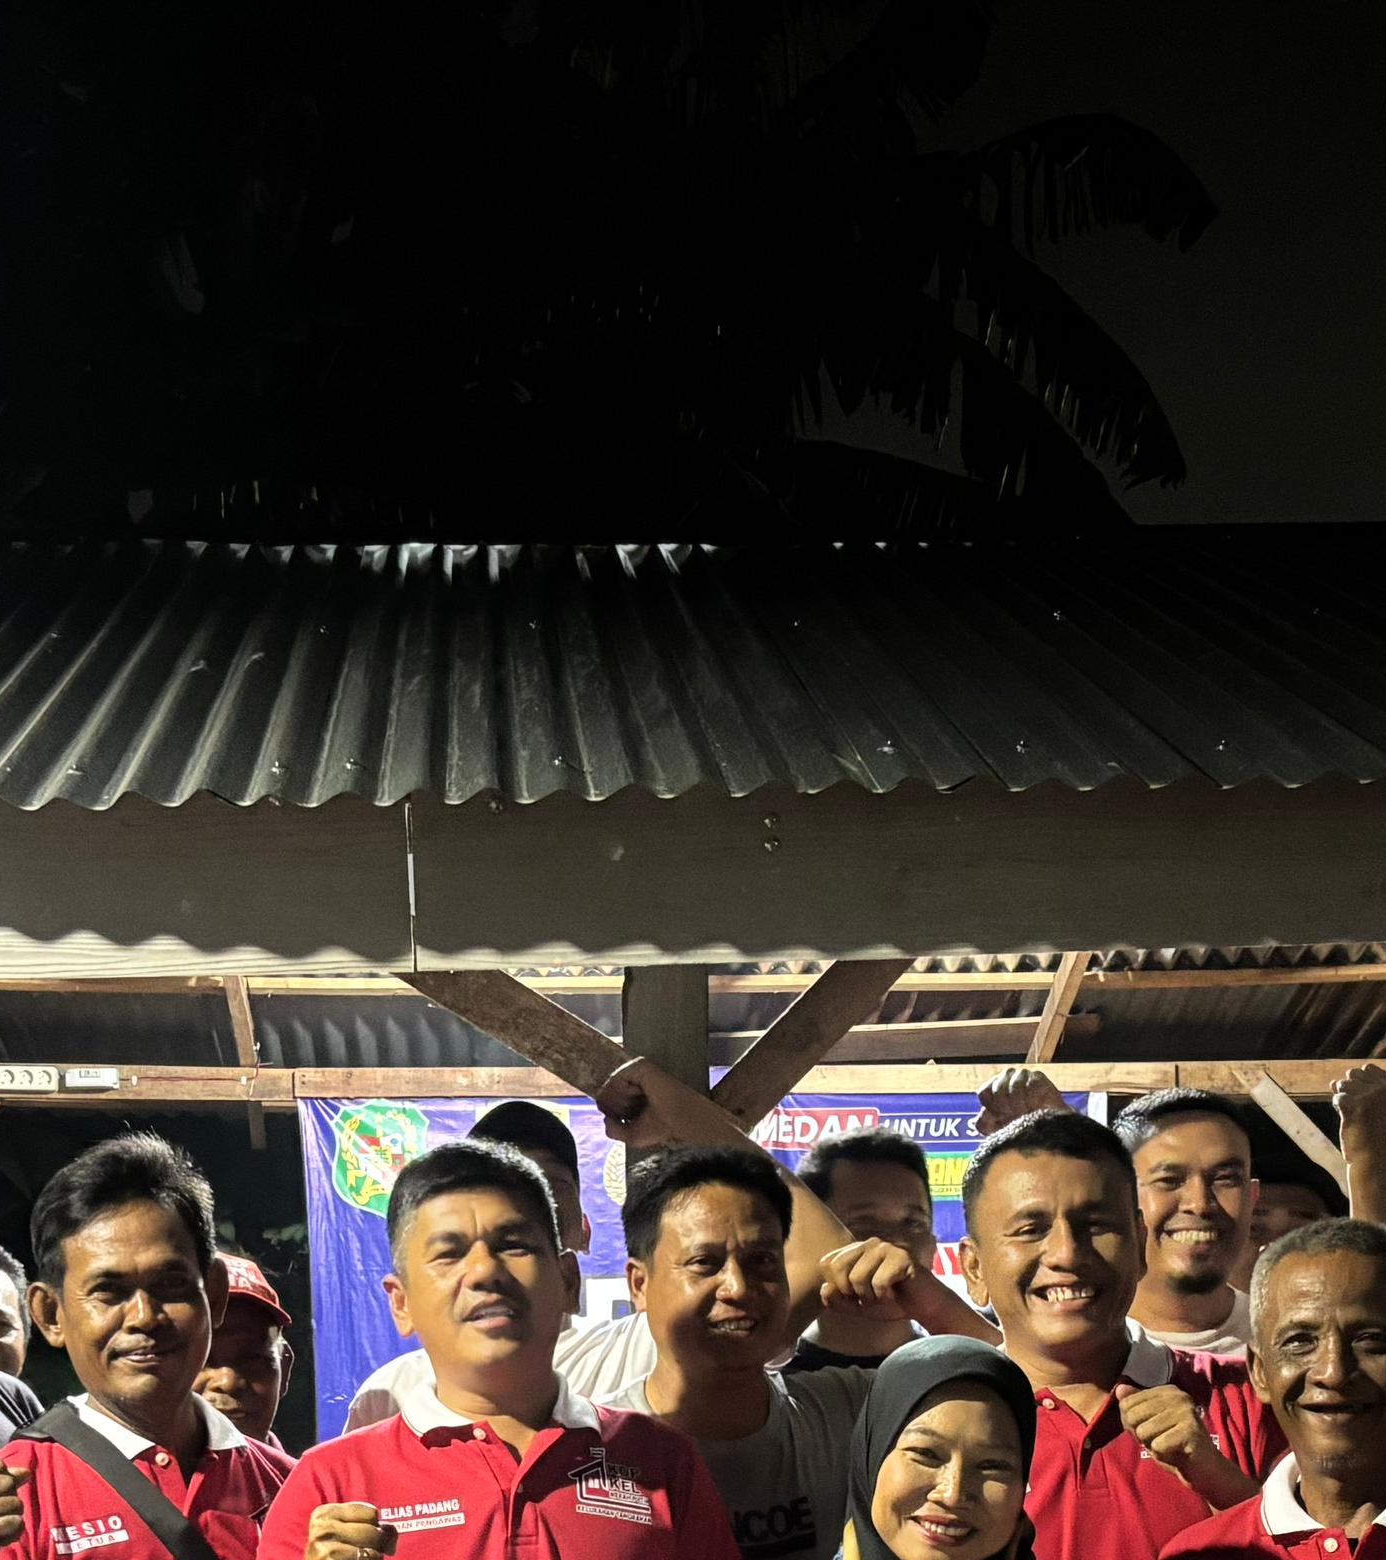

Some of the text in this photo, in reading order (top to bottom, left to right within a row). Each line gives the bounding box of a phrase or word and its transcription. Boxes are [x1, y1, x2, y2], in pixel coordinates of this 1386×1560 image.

[760, 1113, 874, 1145] MEDAN
[885, 1118, 960, 1138] UNTUK
[608, 1476, 642, 1496] KEL
[381, 1498, 460, 1520] ELIAS PADANG
